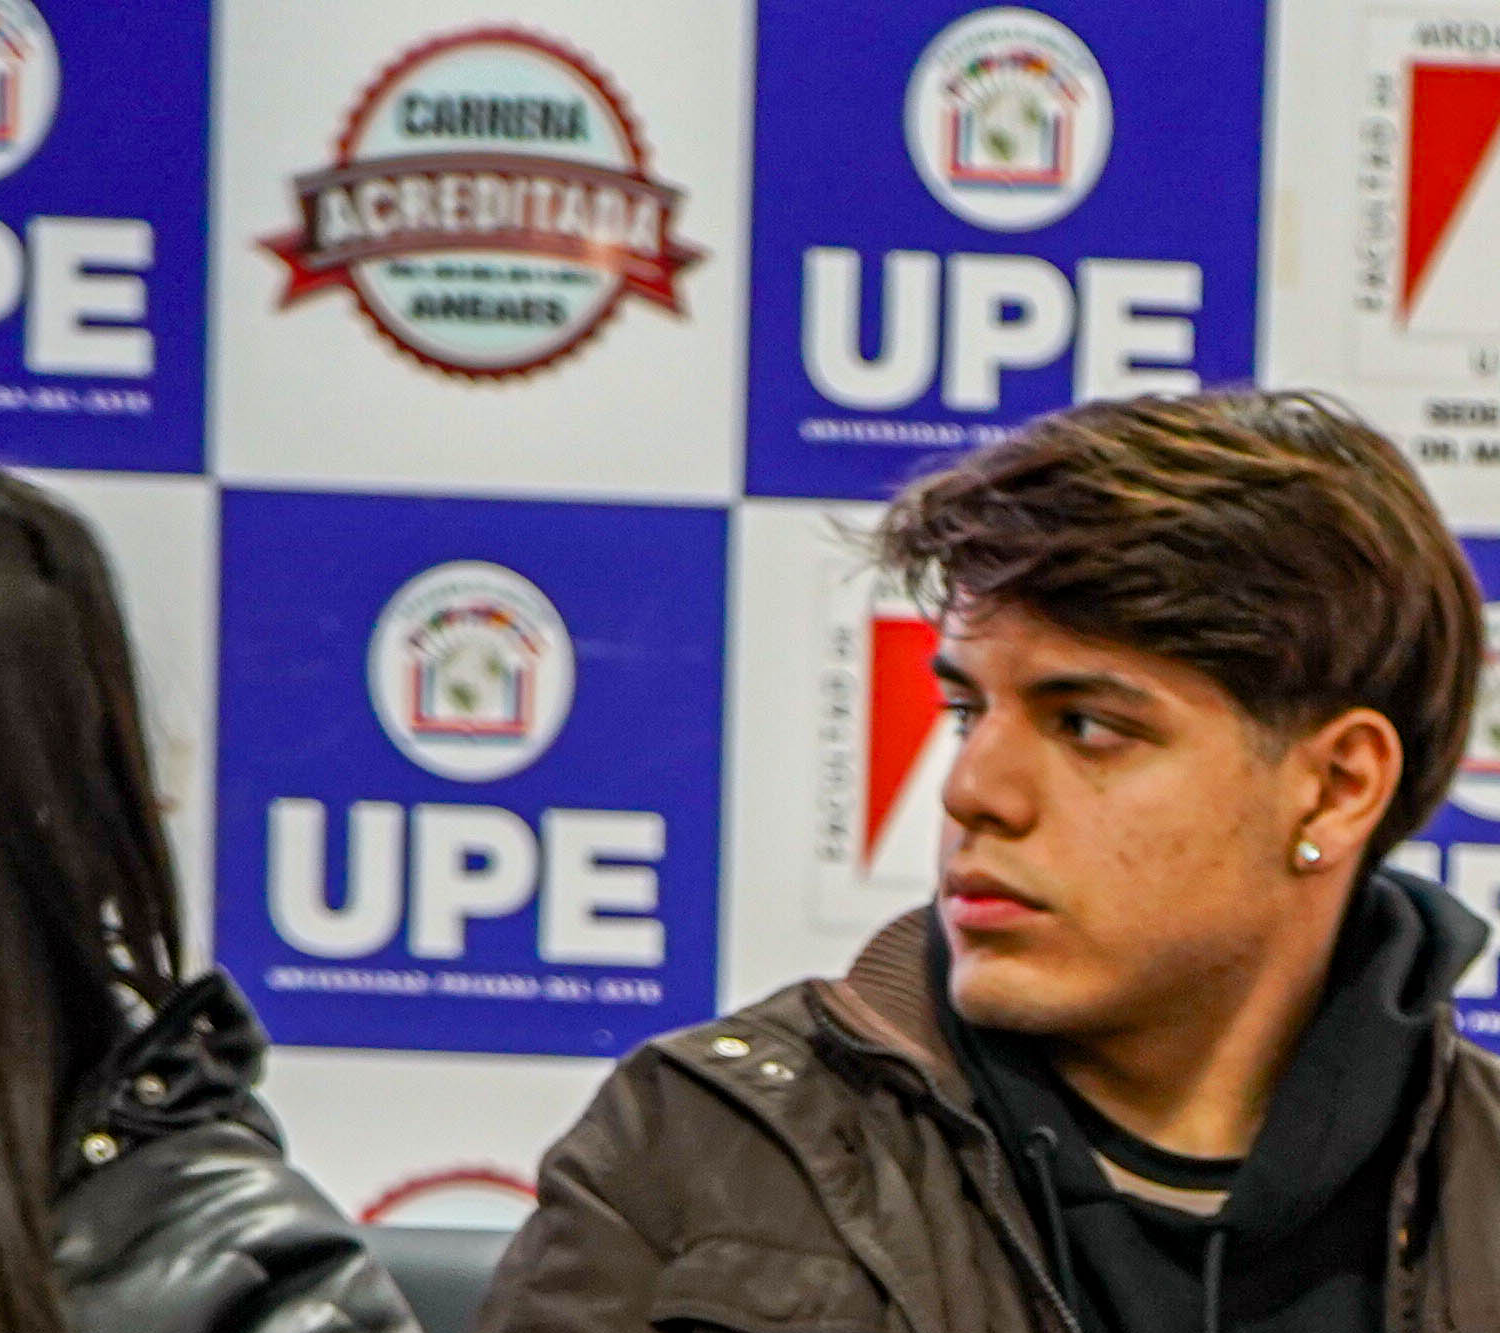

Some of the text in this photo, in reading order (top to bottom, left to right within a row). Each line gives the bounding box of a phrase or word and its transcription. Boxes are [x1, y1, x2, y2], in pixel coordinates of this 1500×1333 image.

[399, 89, 591, 141] CARRERA
[320, 169, 660, 256] ACREDITADA
[409, 293, 568, 327] ANEAES
[802, 247, 1202, 410] UPE
[1425, 399, 1498, 428] SEDE
[268, 798, 666, 965] UPE
